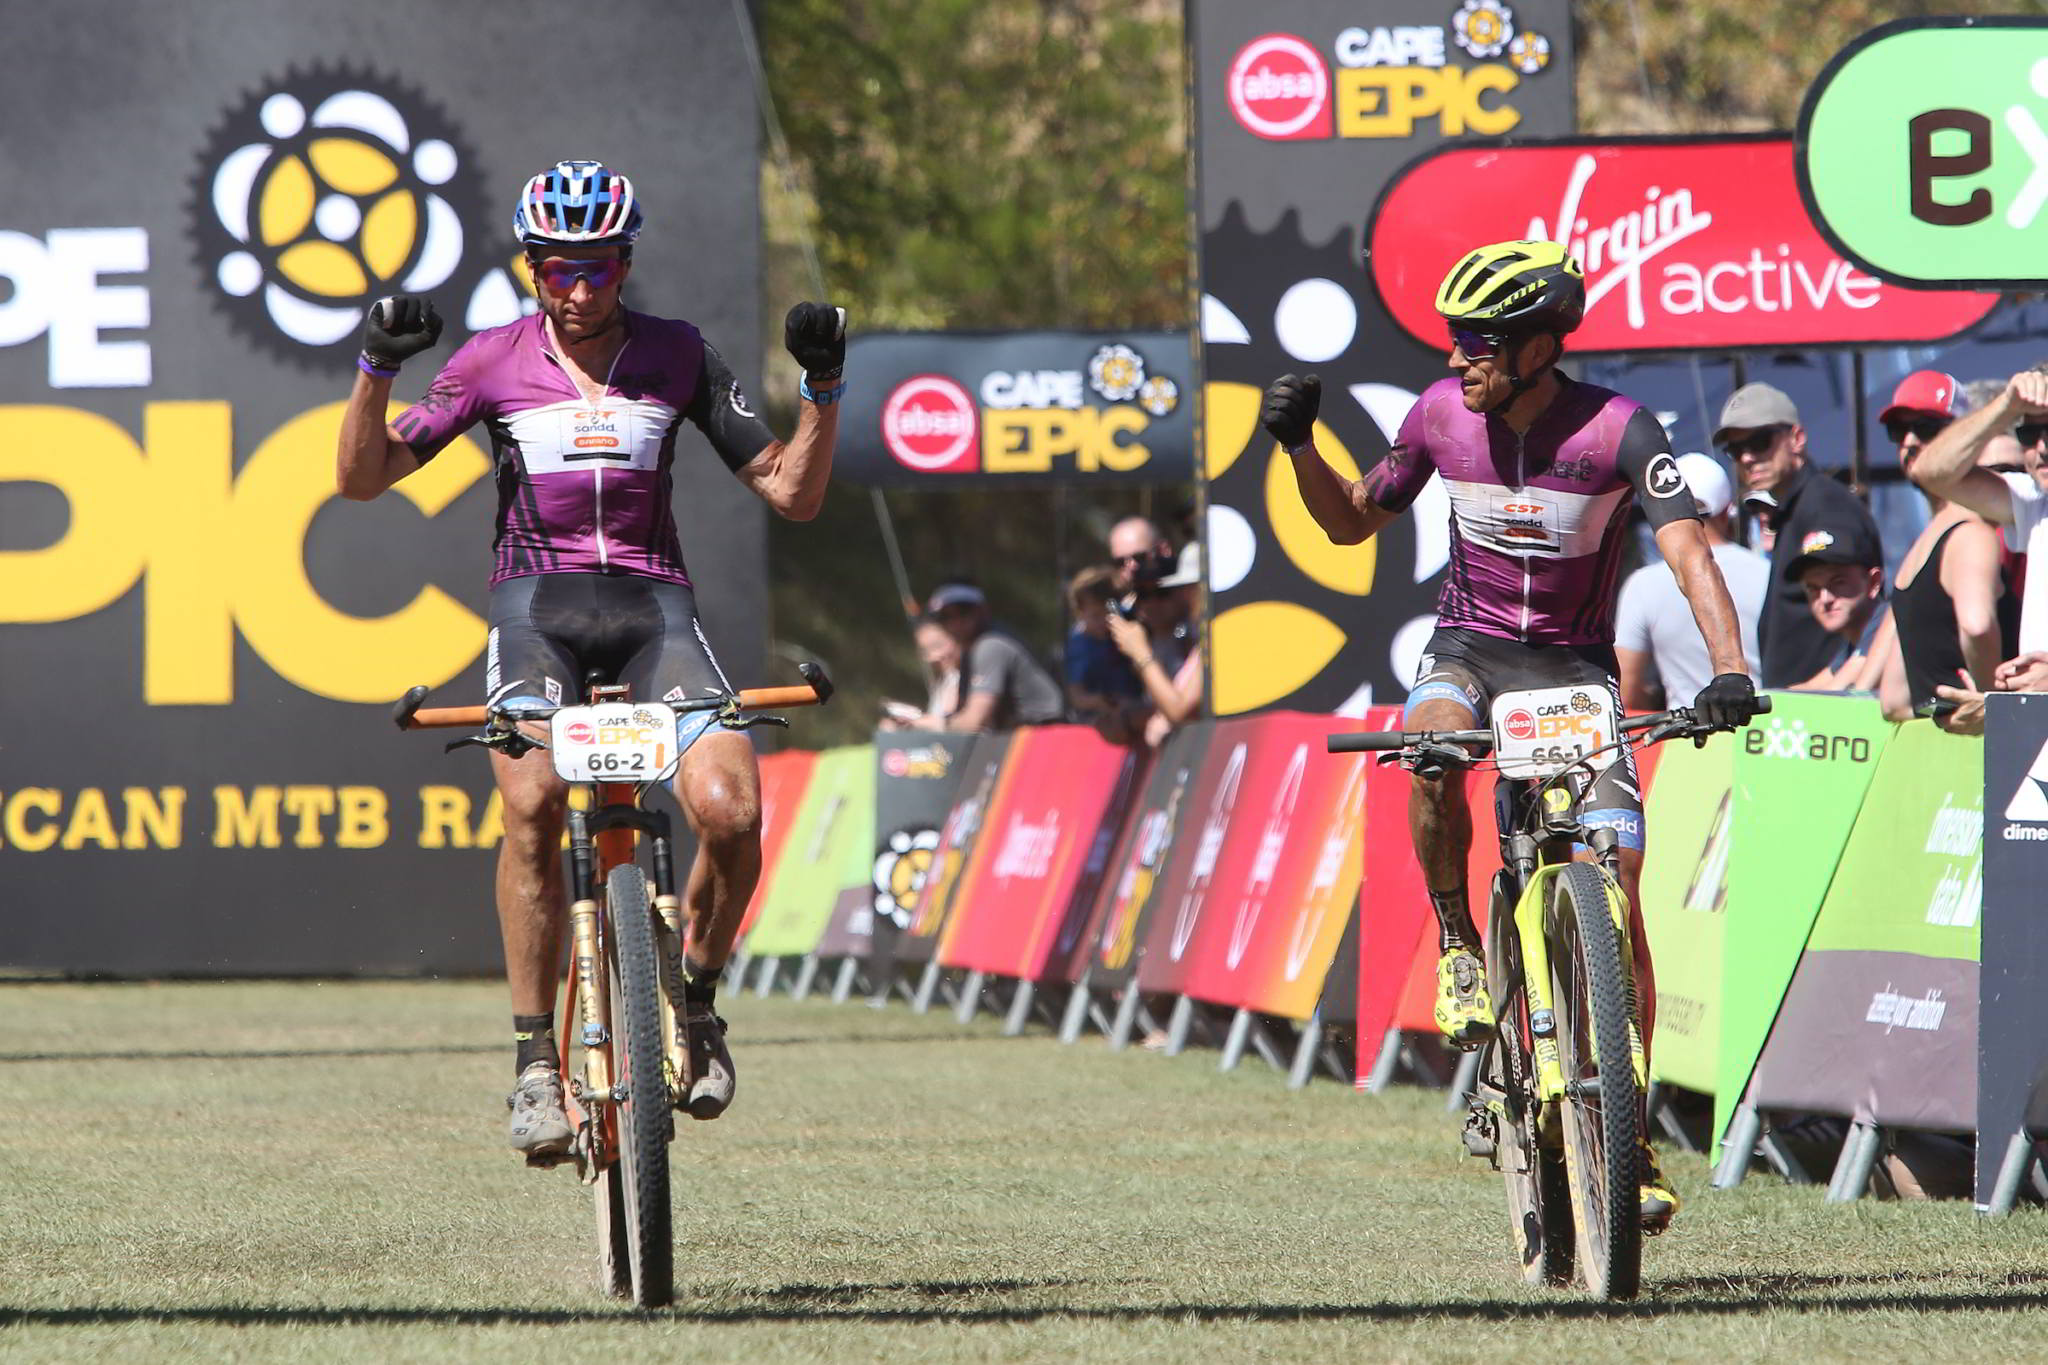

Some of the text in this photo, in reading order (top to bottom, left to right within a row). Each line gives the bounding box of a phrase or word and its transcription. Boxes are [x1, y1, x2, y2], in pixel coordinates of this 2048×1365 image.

[1335, 25, 1446, 67] CAPE
[1244, 66, 1313, 100] absa
[1337, 64, 1520, 137] EPIC
[1525, 153, 1712, 329] Virgin
[1660, 243, 1883, 315] active
[980, 369, 1083, 408] CAPE
[897, 402, 964, 435] absa
[981, 404, 1151, 473] EPIC
[1504, 504, 1545, 514] CST
[599, 718, 630, 726] CAPE
[1507, 719, 1532, 728] absa
[1536, 704, 1569, 717] CAPE
[1538, 714, 1593, 738] EPIC
[599, 727, 653, 744] EPIC
[1745, 718, 1870, 763] exxaro
[587, 753, 645, 771] 66-2
[0, 786, 186, 850] CAN
[212, 785, 389, 849] MTB
